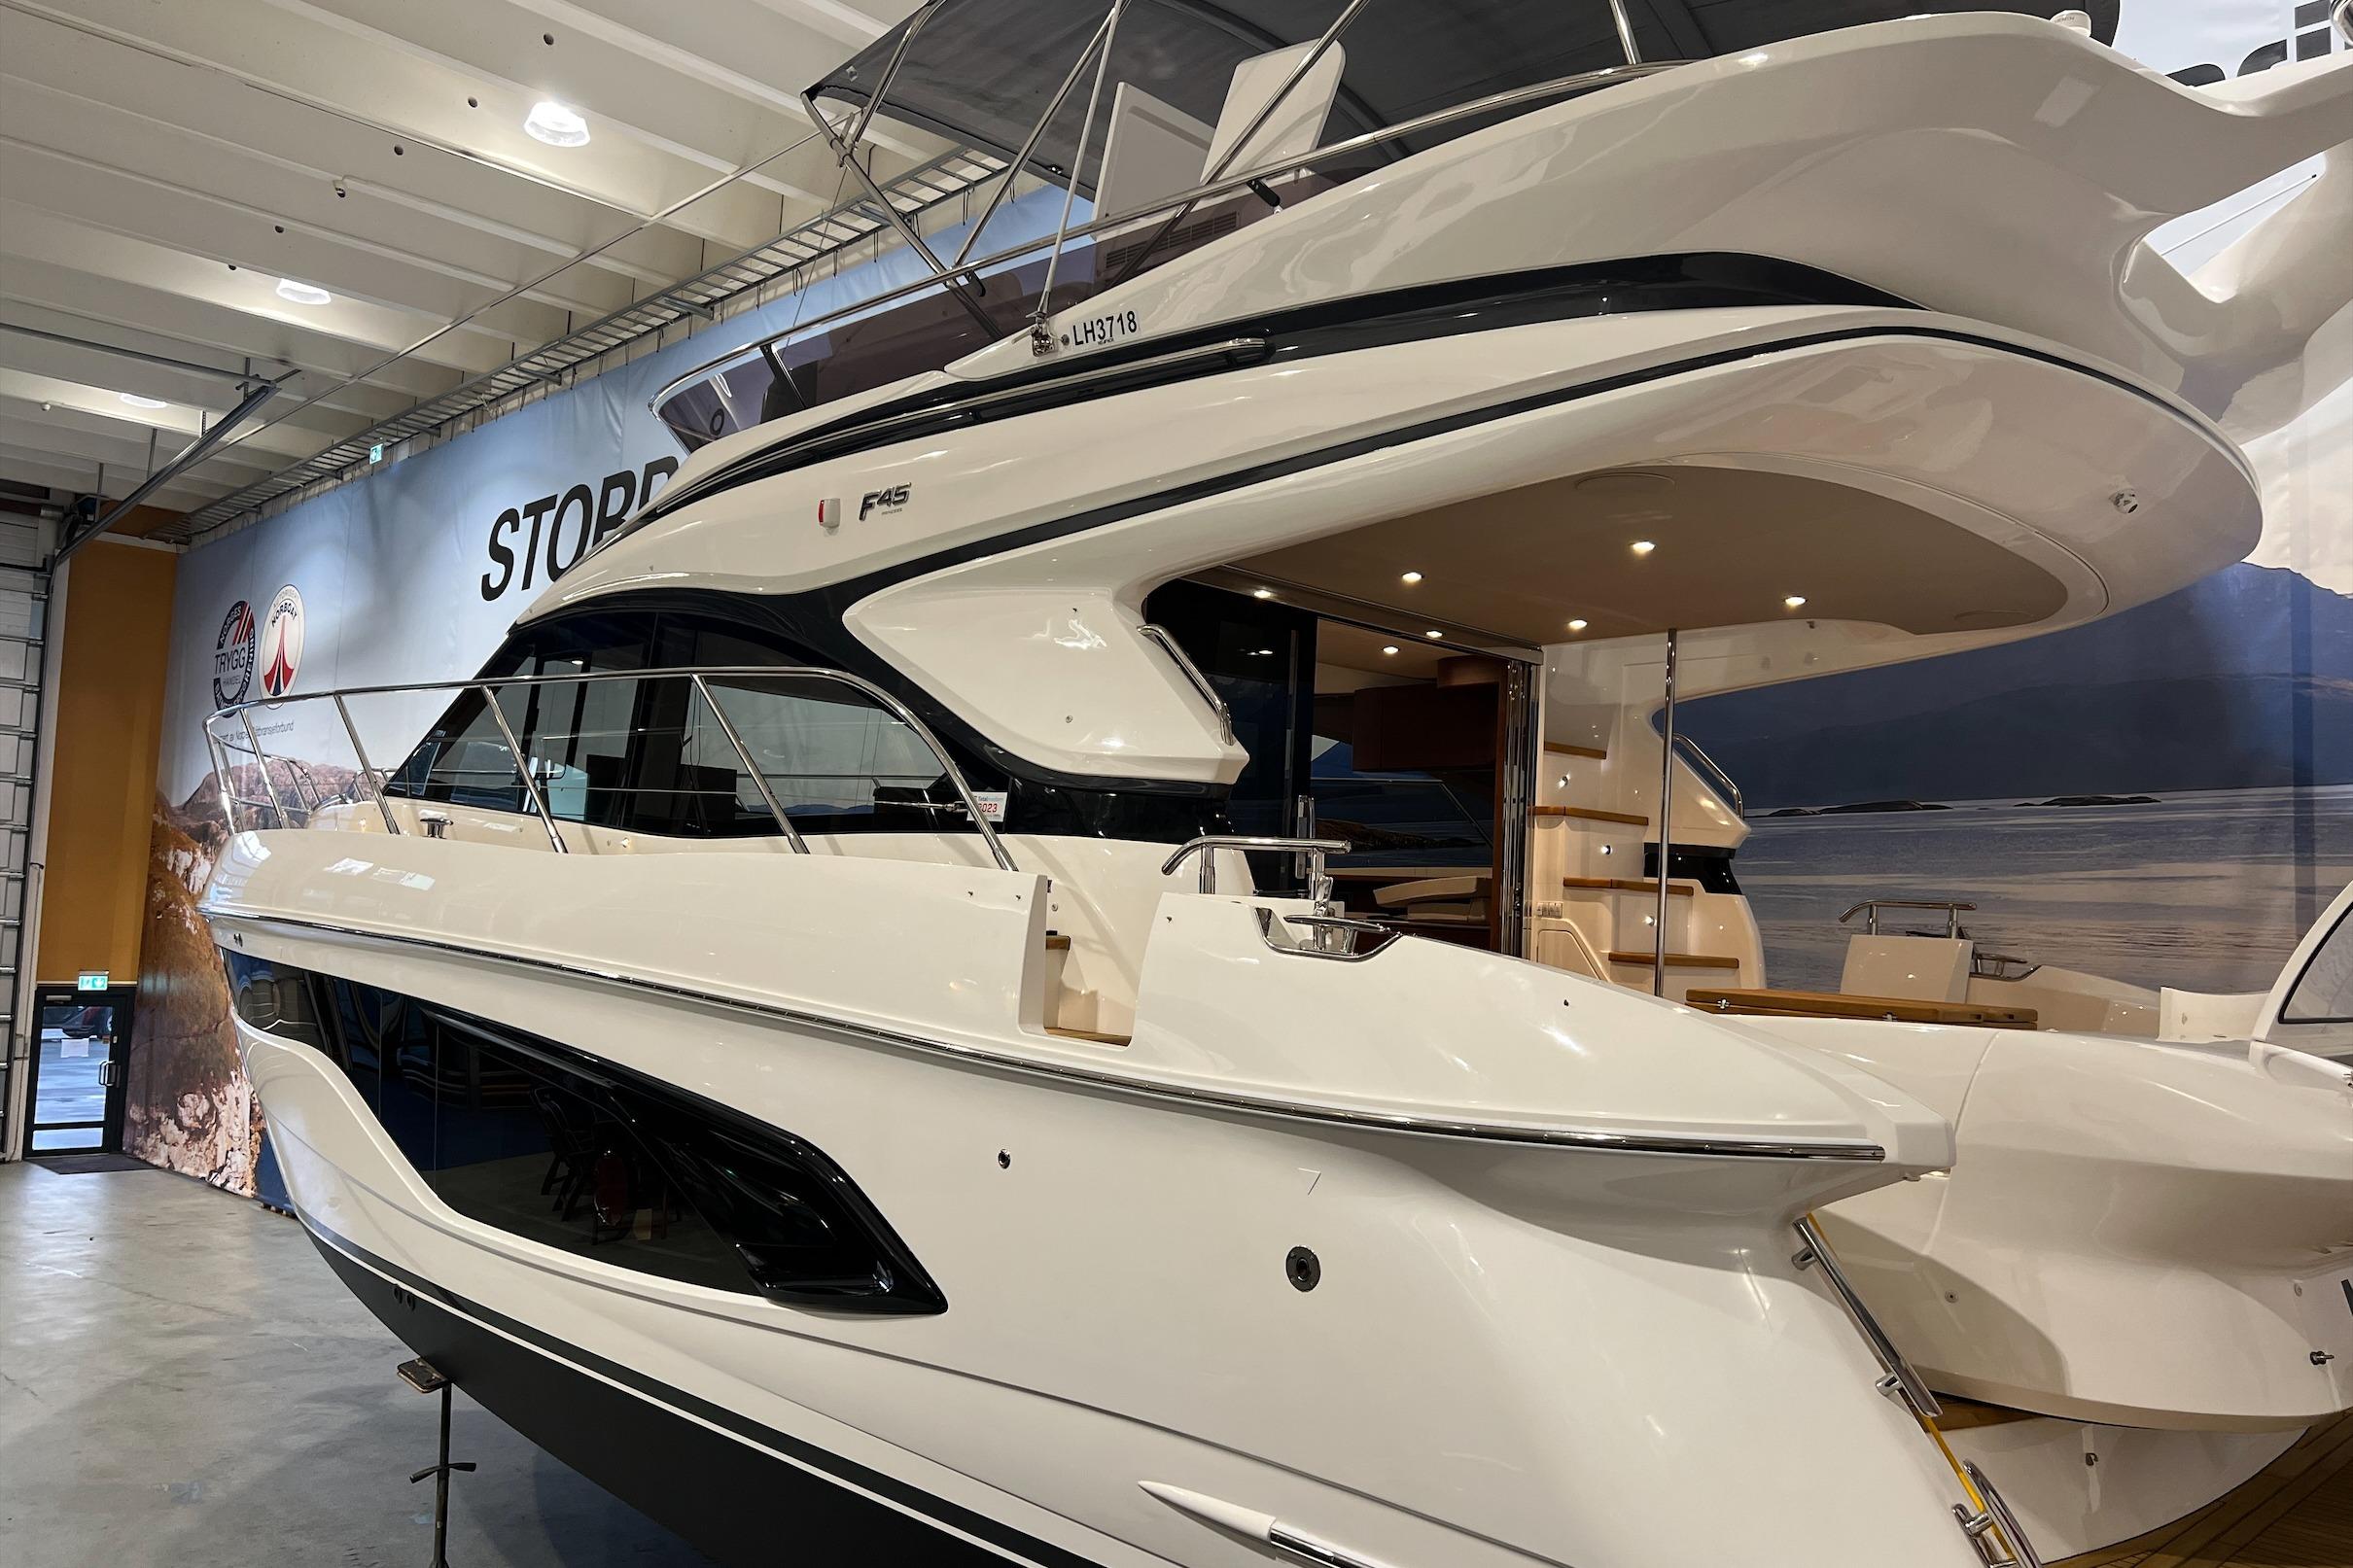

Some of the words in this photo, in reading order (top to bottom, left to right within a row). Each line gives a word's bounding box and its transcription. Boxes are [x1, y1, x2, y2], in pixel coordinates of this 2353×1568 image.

[1072, 310, 1138, 346] LH3718
[859, 482, 912, 522] F45
[271, 602, 298, 628] NORBOAT
[215, 646, 246, 675] TRYGG
